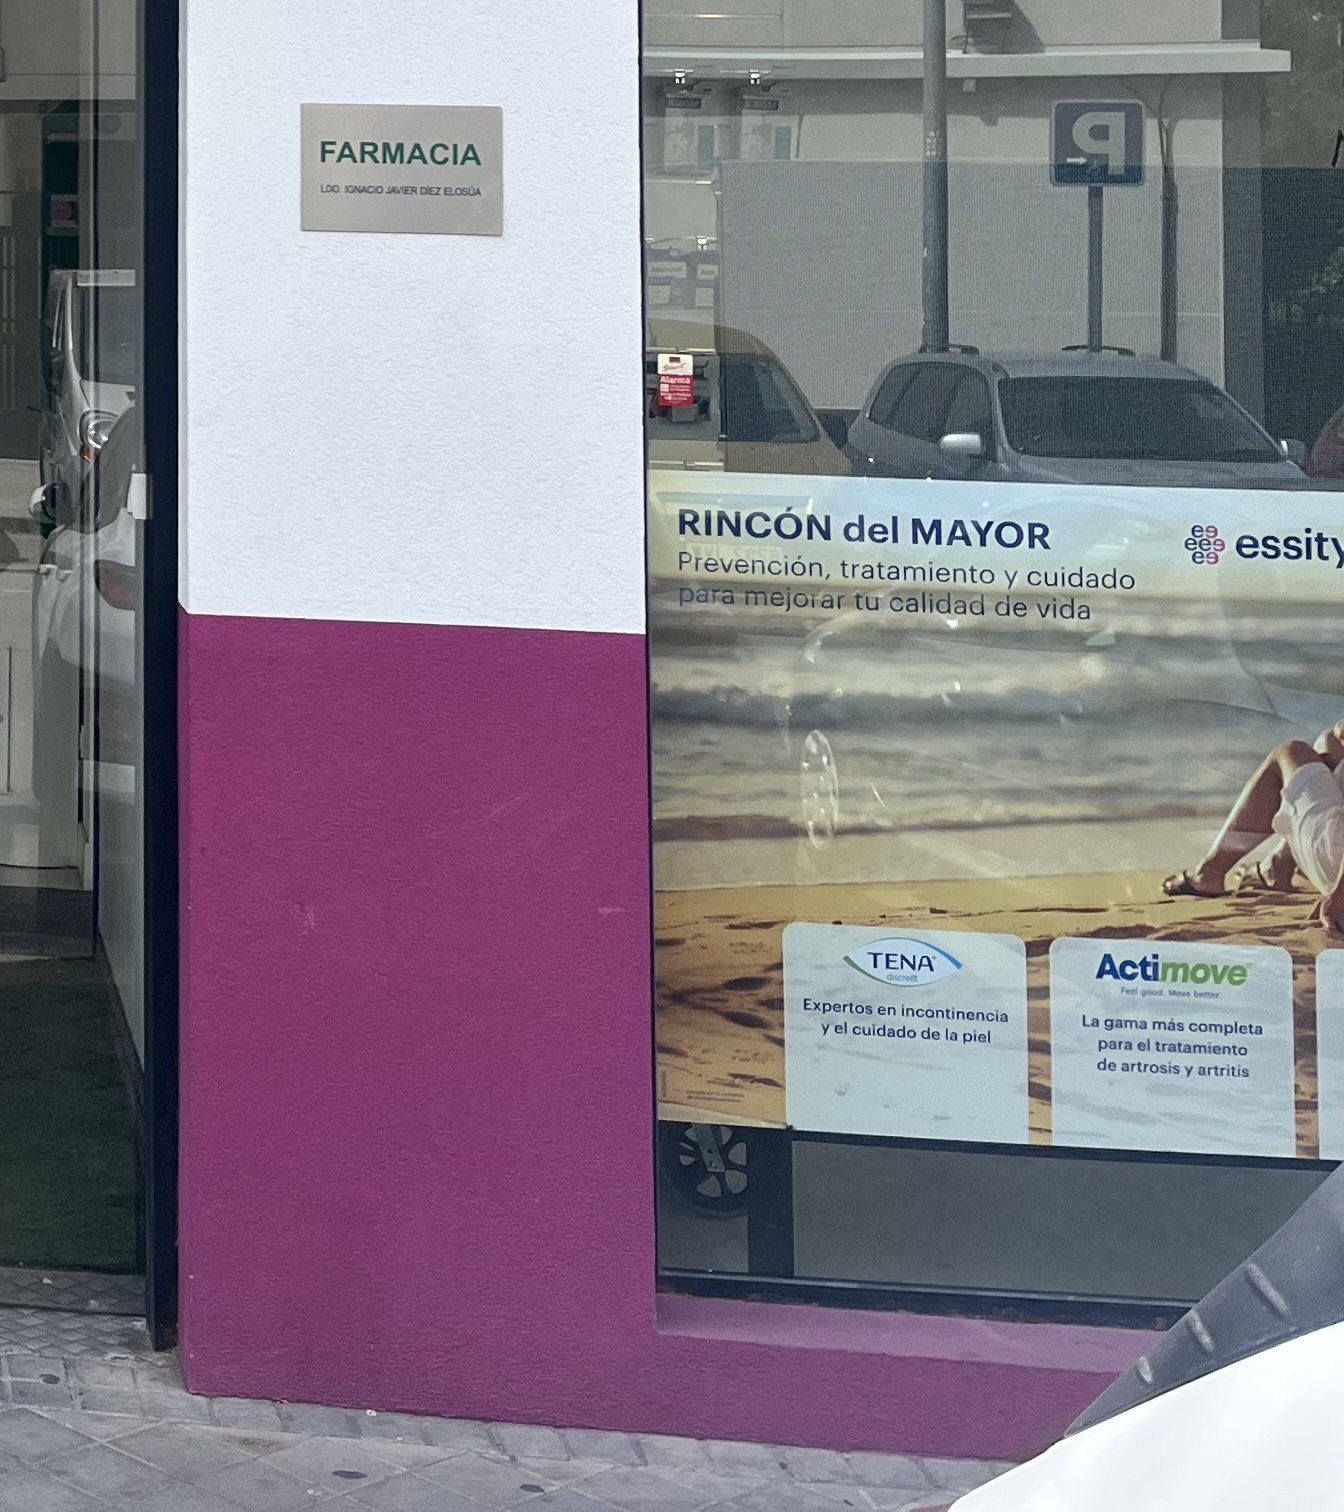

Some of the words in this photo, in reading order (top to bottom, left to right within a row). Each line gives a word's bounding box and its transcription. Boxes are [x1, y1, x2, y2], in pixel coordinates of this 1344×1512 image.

[319, 140, 482, 166] FARMACIA
[320, 184, 341, 194] LDO.
[344, 185, 384, 194] IGNACIO
[386, 185, 418, 195] JAVIER
[678, 507, 832, 543] RINCÓN
[842, 515, 899, 544] del
[911, 517, 1052, 551] MAYOR
[1235, 527, 1344, 569] essity
[678, 551, 831, 582] Prevención,
[840, 560, 996, 586] tratamiento
[1004, 568, 1019, 589] y
[1026, 566, 1137, 591] cuidado
[678, 586, 736, 608] para
[744, 586, 846, 613] mejorar
[854, 591, 881, 613] tu
[888, 592, 986, 617] calidad
[995, 595, 1029, 619] de
[1036, 597, 1092, 621] vida
[867, 952, 935, 972] TENA
[1095, 953, 1249, 986] Actimove
[1120, 986, 1138, 996] Feel
[1168, 989, 1191, 998] Move
[803, 998, 873, 1015] Expertos
[877, 1006, 896, 1017] en
[901, 1004, 1009, 1023] incontinencia
[821, 1023, 830, 1035] y
[834, 1022, 848, 1035] el
[852, 1023, 917, 1039] cuidado
[921, 1027, 941, 1041] de
[945, 1028, 958, 1042] la
[963, 1029, 992, 1045] piel
[1082, 1014, 1100, 1028] La
[1104, 1018, 1148, 1031] gama
[1152, 1016, 1185, 1032] más
[1188, 1019, 1263, 1036] completa
[1098, 1039, 1133, 1052] para
[1137, 1039, 1151, 1052] el
[1155, 1041, 1248, 1056] tratamiento
[1097, 1057, 1117, 1072] de
[1120, 1060, 1180, 1075] artrosis
[1184, 1065, 1194, 1077] y
[1197, 1064, 1250, 1078] artritis
